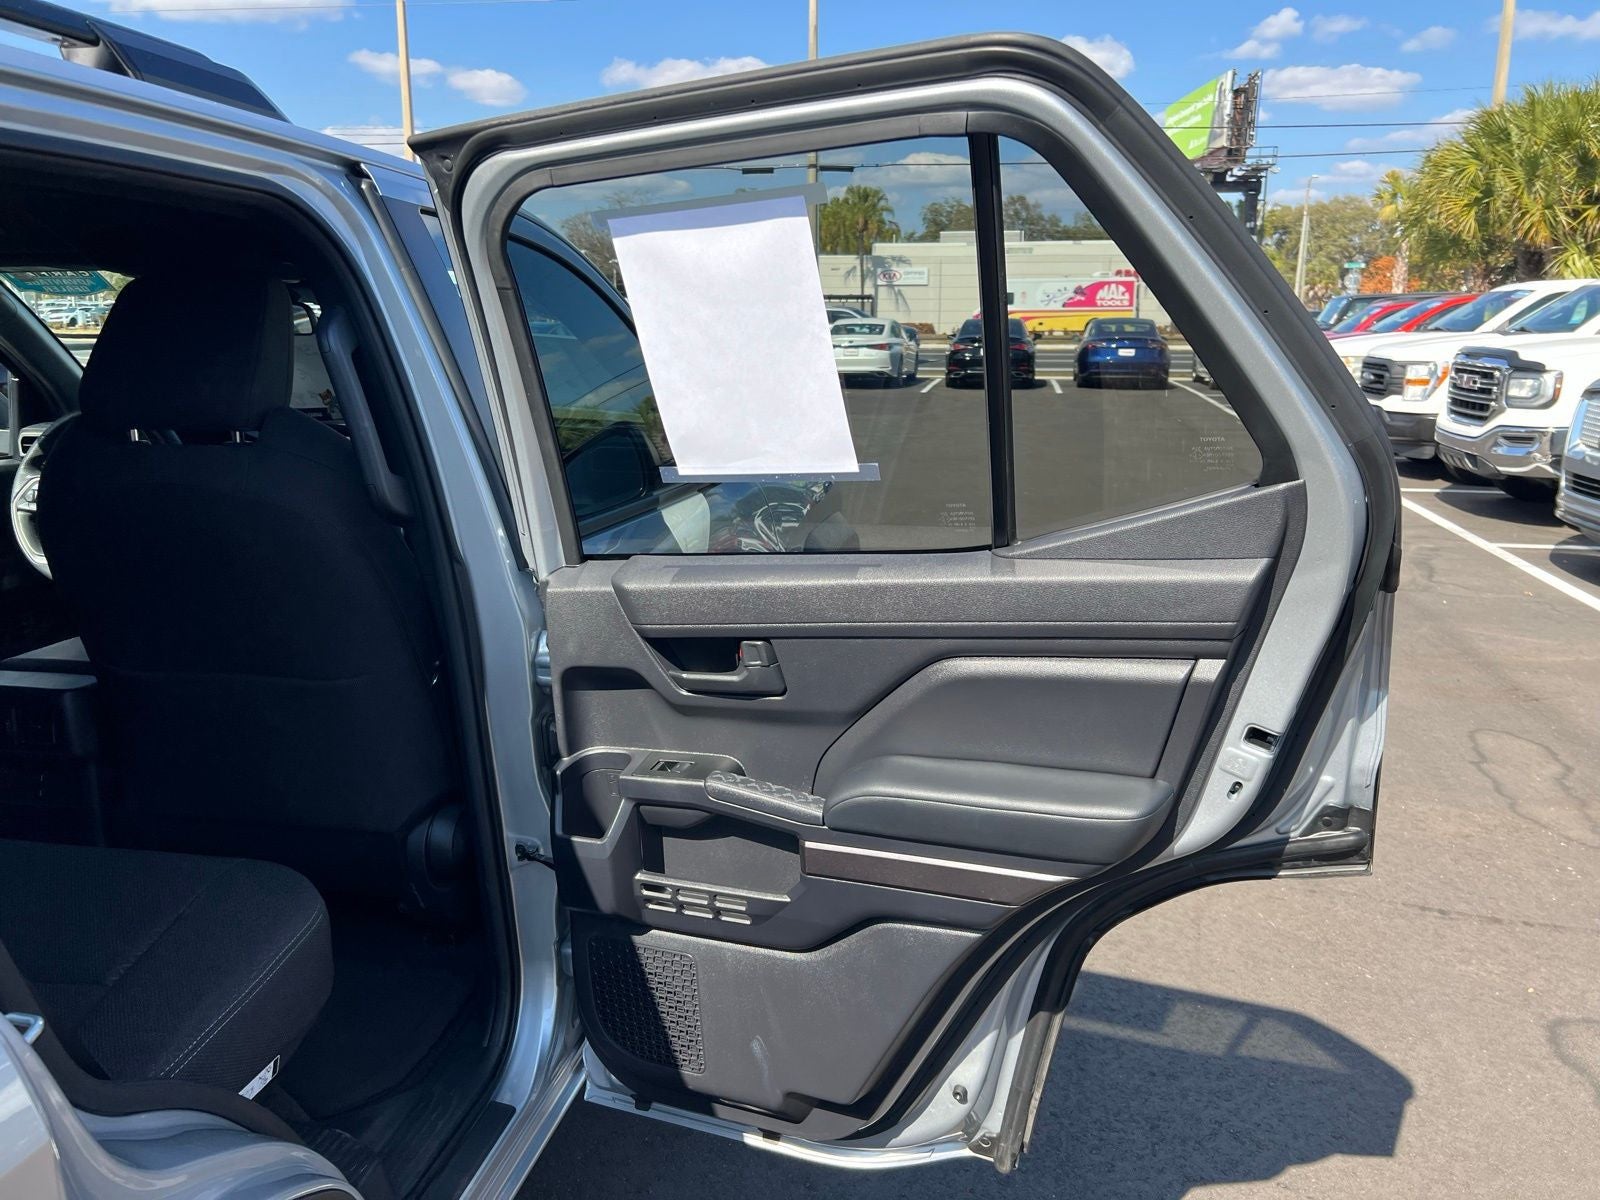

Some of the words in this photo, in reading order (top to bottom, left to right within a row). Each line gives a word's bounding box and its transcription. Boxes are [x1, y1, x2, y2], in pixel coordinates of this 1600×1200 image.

[882, 272, 898, 281] KIA
[1095, 283, 1130, 300] MAC
[1095, 299, 1130, 307] TOOLS
